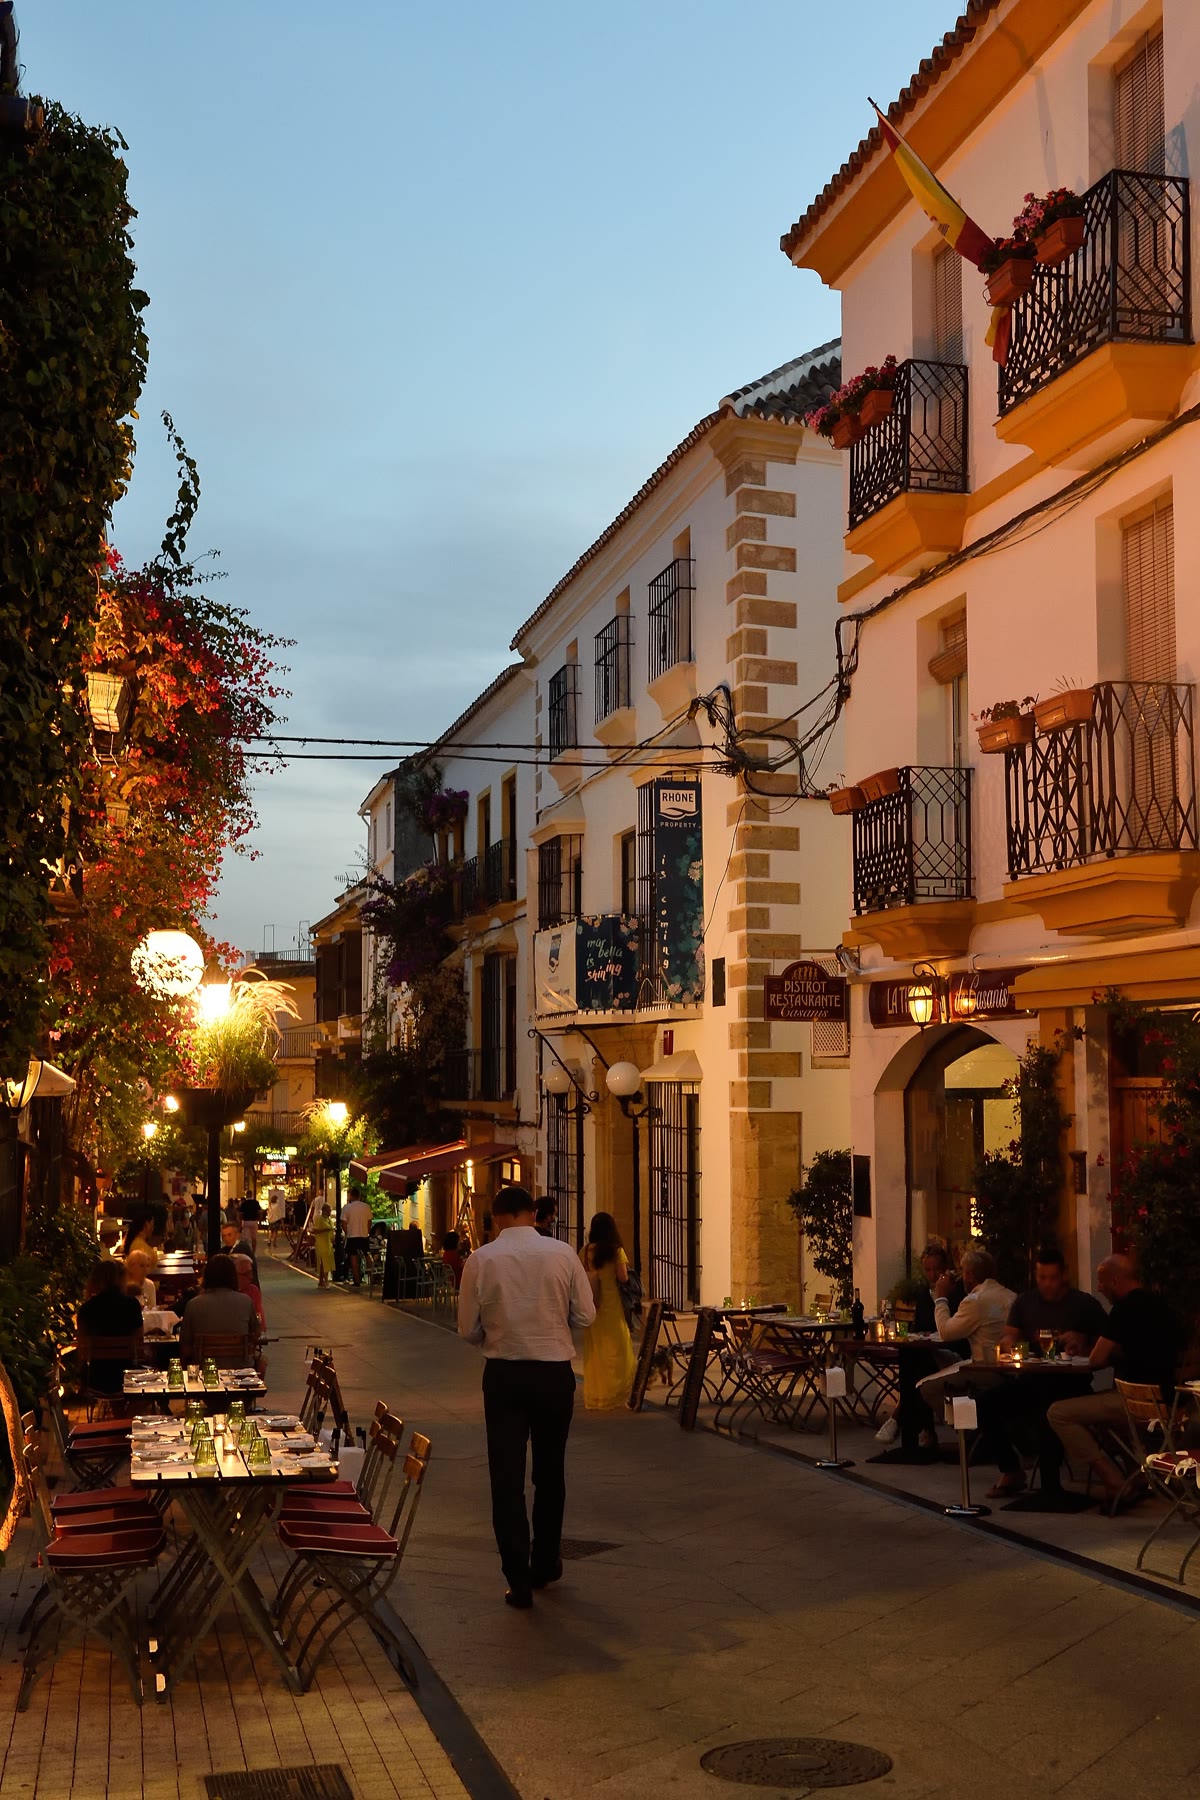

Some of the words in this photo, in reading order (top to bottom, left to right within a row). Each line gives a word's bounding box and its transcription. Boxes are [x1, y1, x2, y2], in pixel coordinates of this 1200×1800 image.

[586, 953, 595, 968] is
[784, 980, 827, 993] BISTROT
[769, 993, 841, 1007] RESTAURANTE
[887, 987, 898, 1014] LA
[780, 1004, 829, 1018] Casanis
